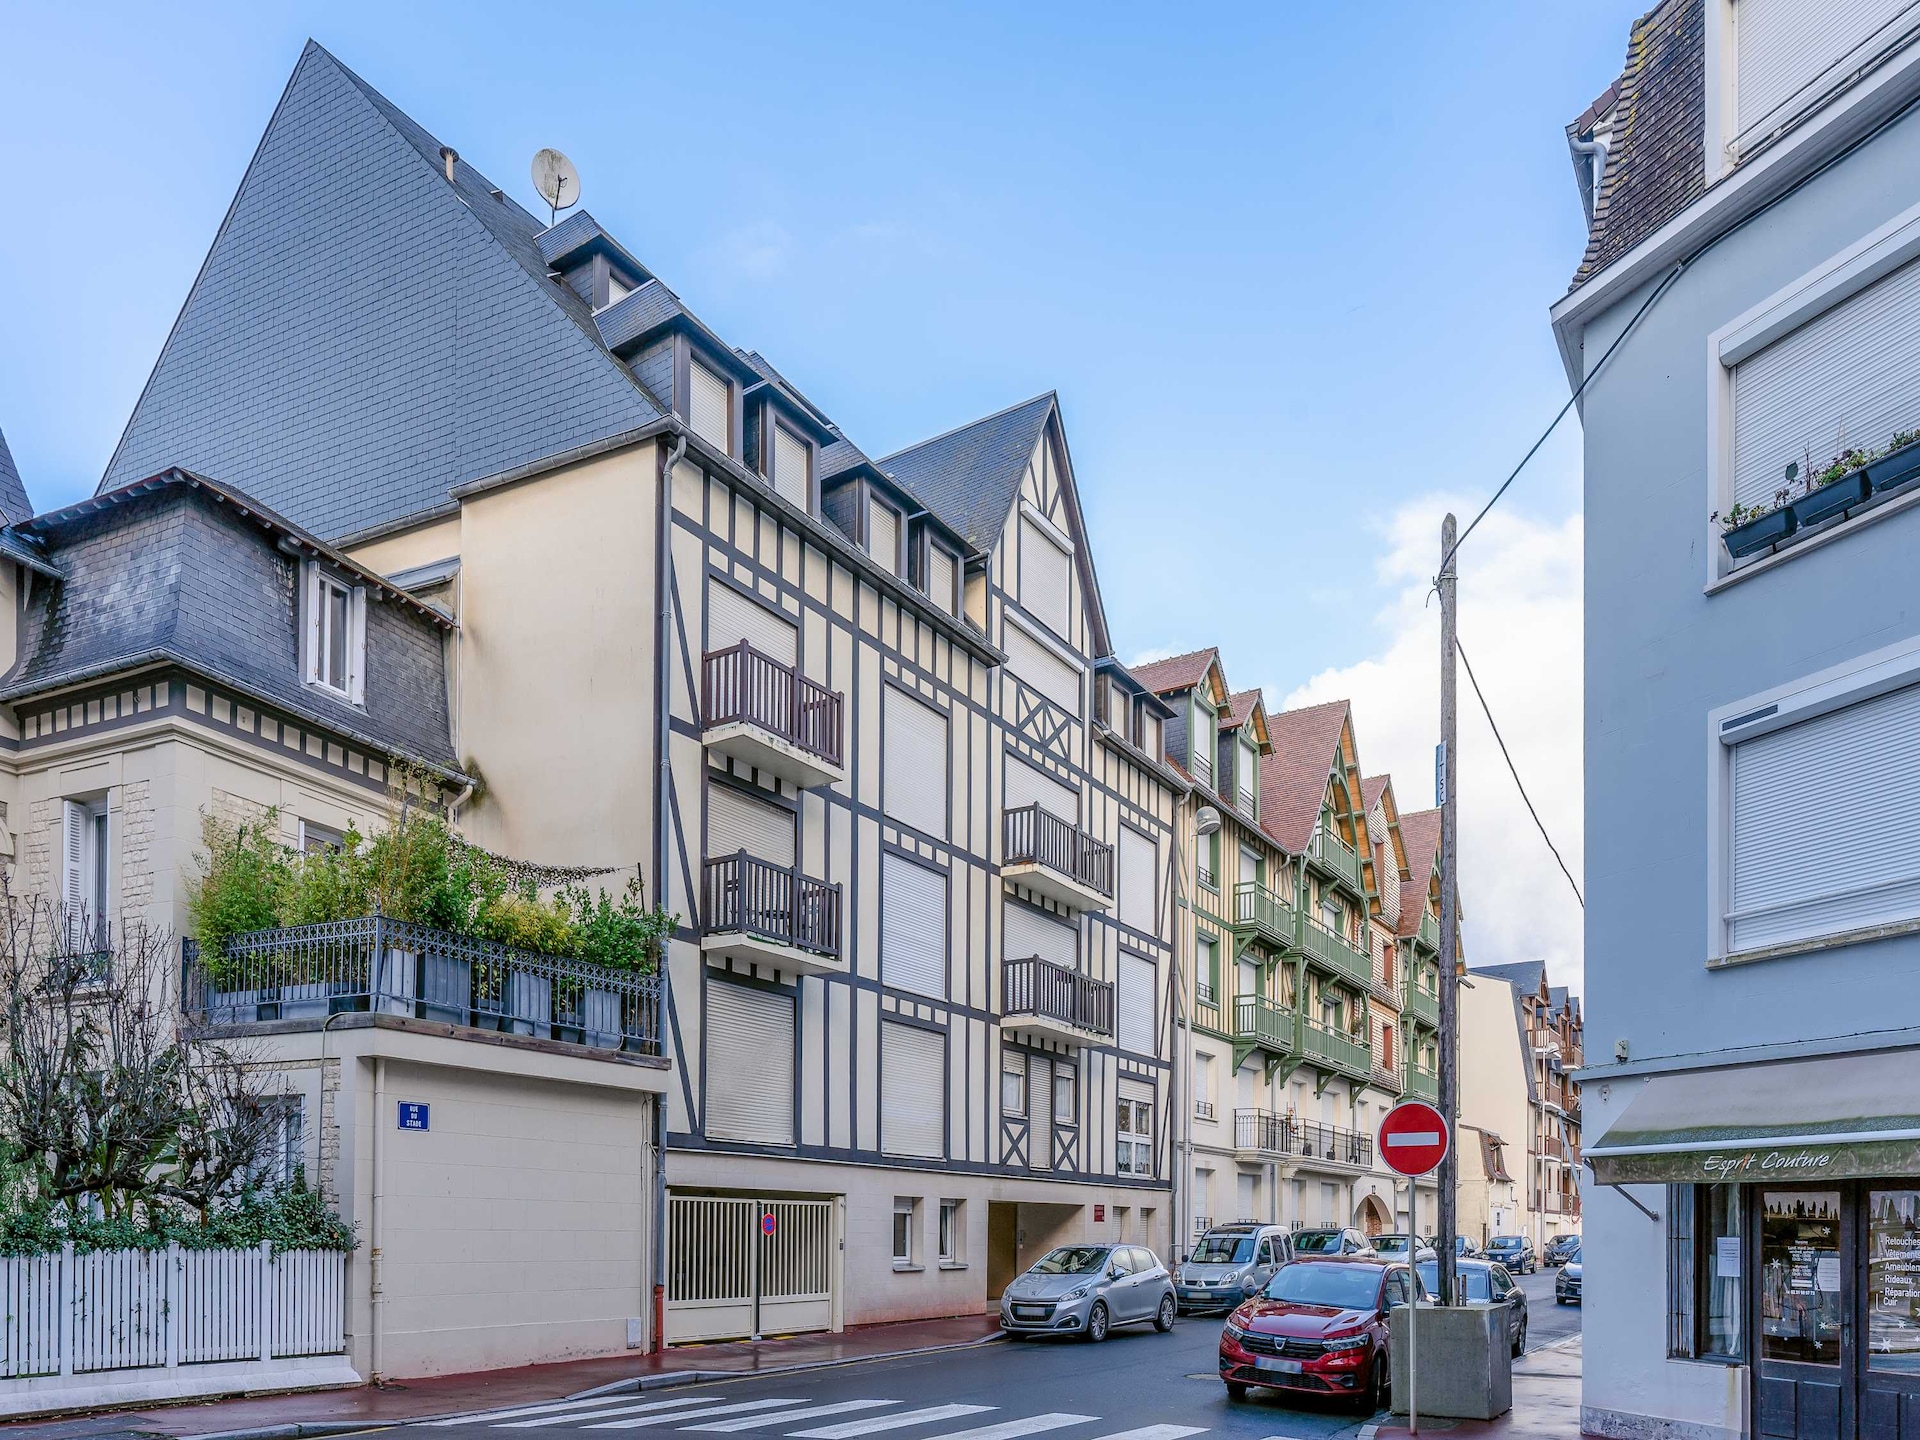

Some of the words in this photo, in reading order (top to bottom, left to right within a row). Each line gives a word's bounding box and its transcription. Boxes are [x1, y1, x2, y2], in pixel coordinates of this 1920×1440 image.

[1762, 1150, 1830, 1169] Couture
[1885, 1236, 1920, 1246] Retouches
[1885, 1274, 1913, 1284] Rideaux
[1883, 1297, 1898, 1306] Cuir
